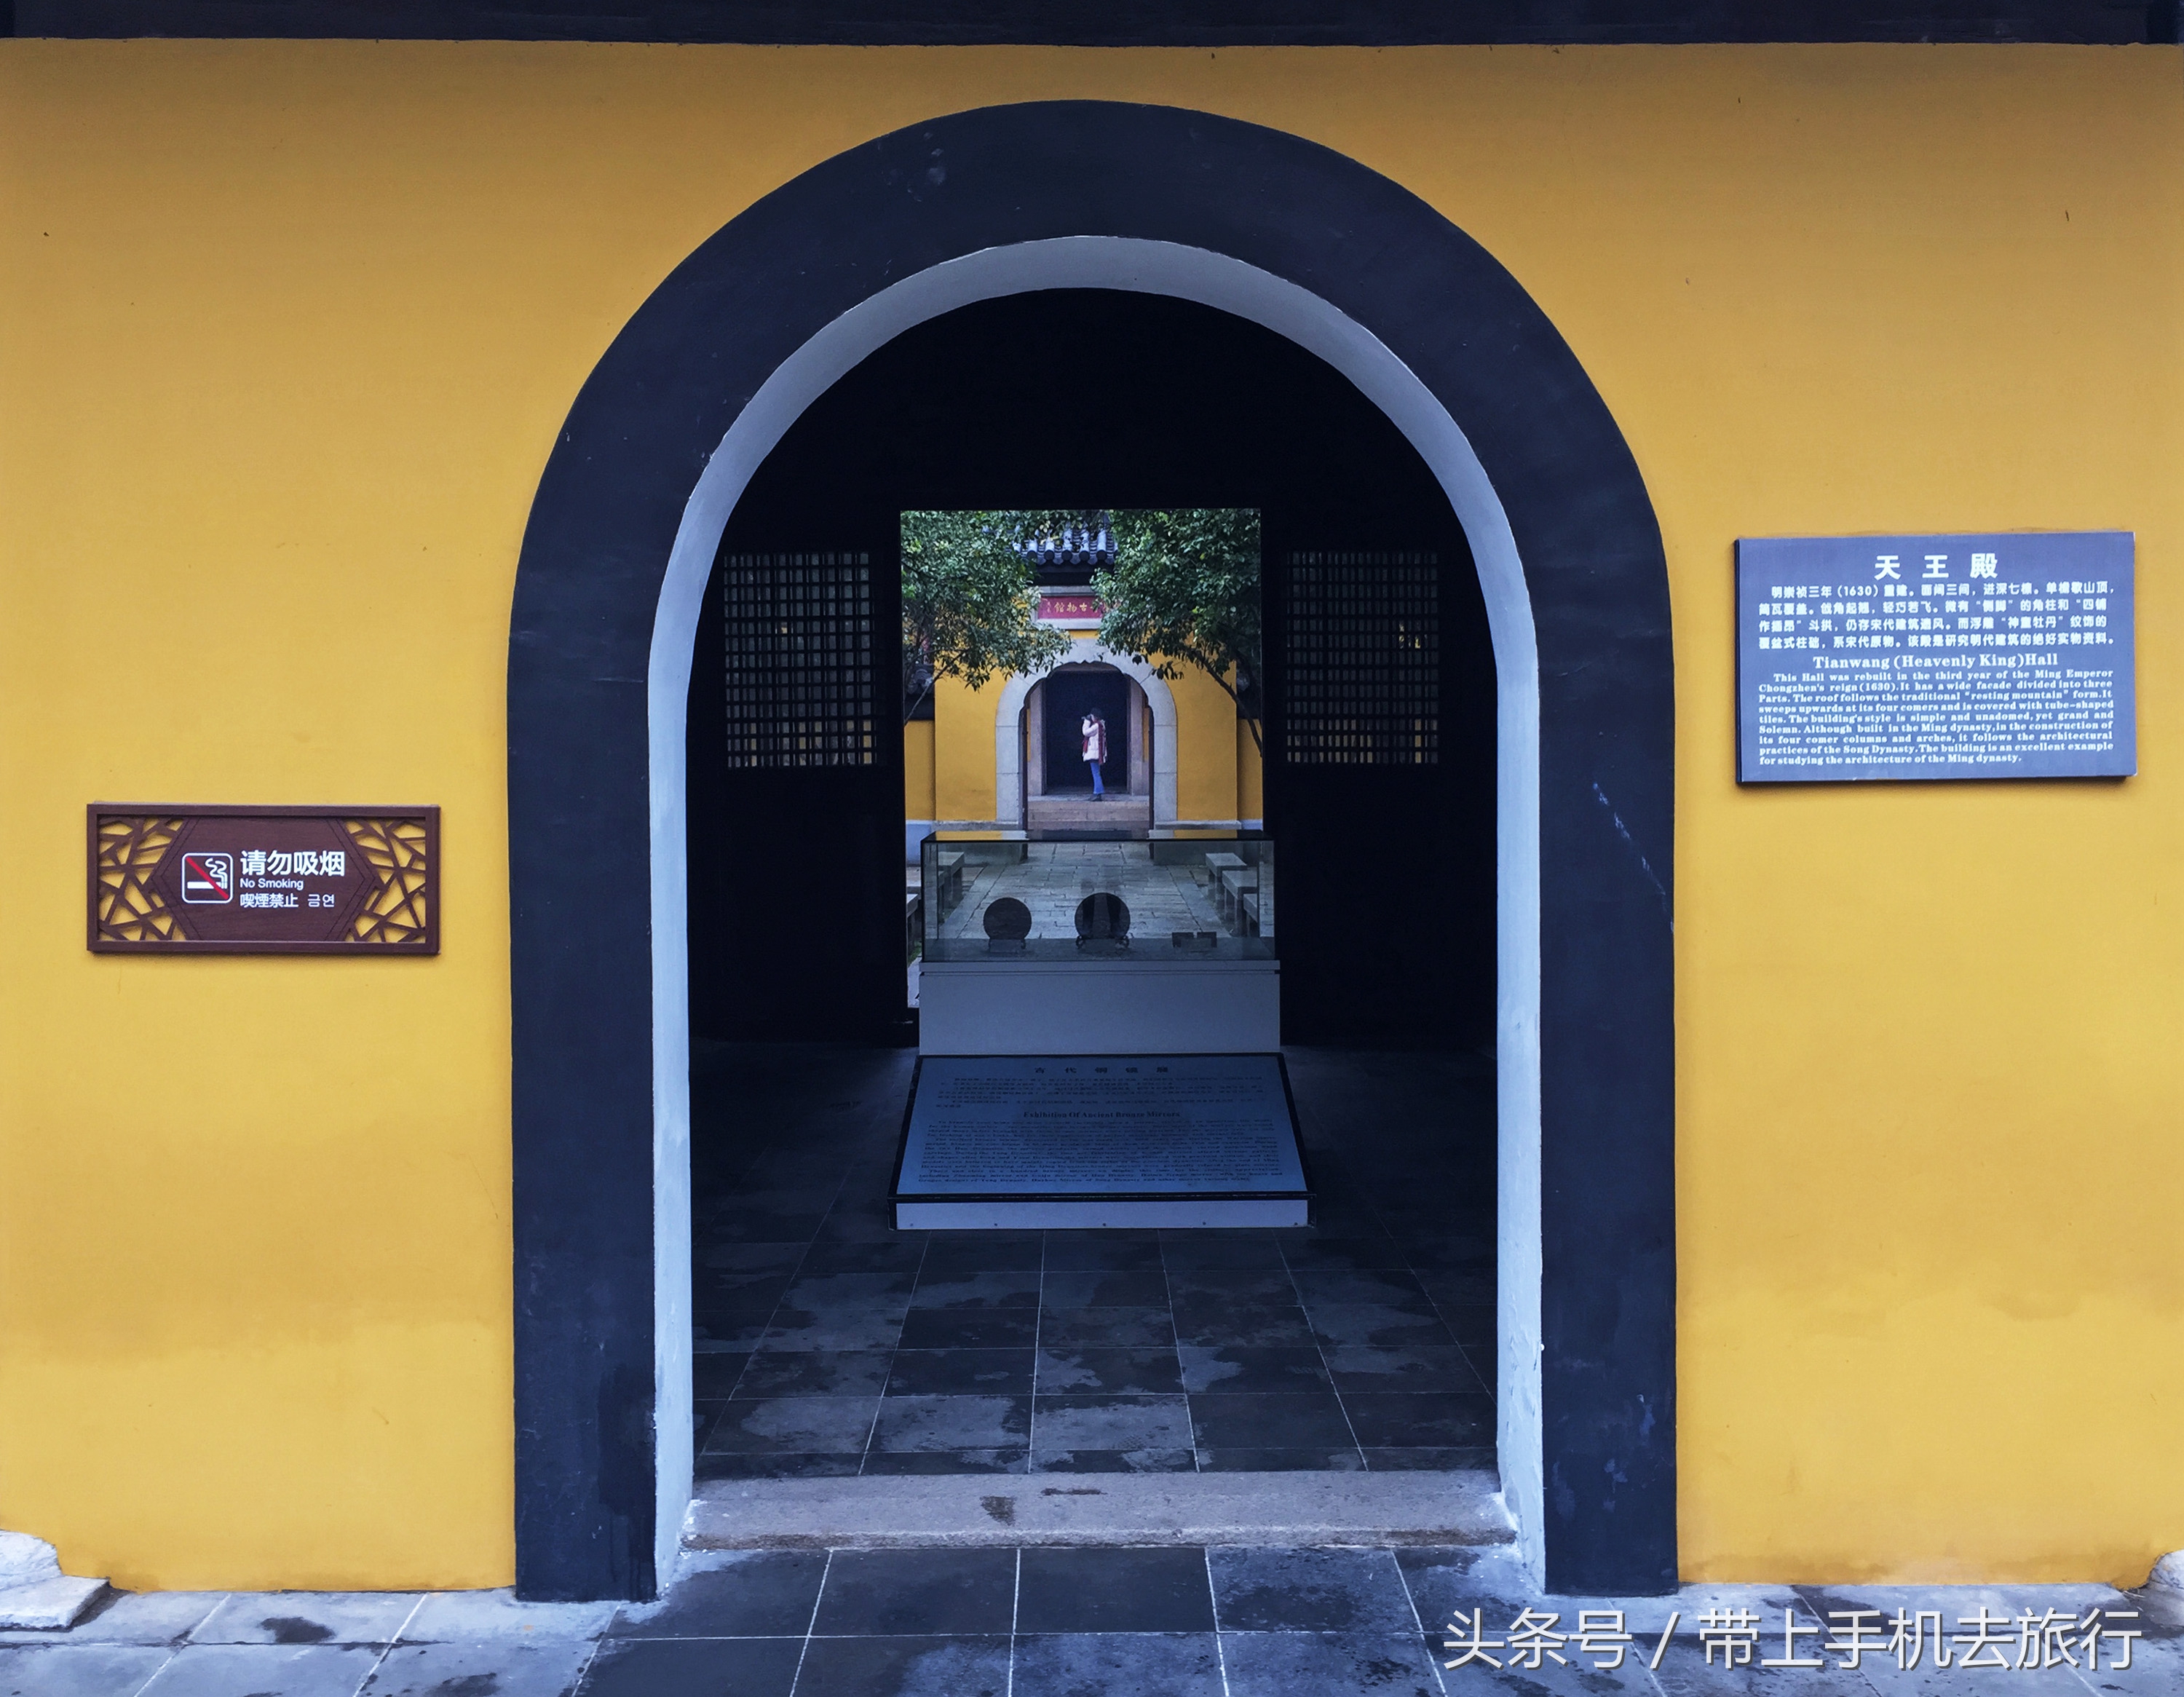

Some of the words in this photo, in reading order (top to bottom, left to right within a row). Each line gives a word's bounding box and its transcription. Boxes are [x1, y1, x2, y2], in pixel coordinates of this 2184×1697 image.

[1875, 553, 1998, 581] 天王殿
[1813, 657, 1891, 671] Tianwang
[1773, 673, 1797, 682] This
[1803, 673, 1824, 682] Hall
[1855, 672, 1892, 681] rebuilt
[1897, 672, 1908, 681] in
[1913, 672, 1930, 681] the
[1936, 671, 1962, 680] third
[1968, 673, 1991, 681] year
[1996, 671, 2009, 679] of
[2013, 671, 2030, 679] the
[2035, 670, 2062, 680] Ming
[2067, 669, 2113, 679] Emperor
[1915, 682, 1933, 691] has
[1947, 681, 1971, 690] wide
[1977, 681, 2011, 690] facade
[2017, 681, 2057, 689] divided
[2059, 680, 2081, 689] into
[2084, 679, 2113, 688] three
[1759, 695, 1791, 703] Parts.
[1793, 694, 1813, 703] The
[1816, 694, 1839, 703] roof
[1840, 694, 1880, 702] follows
[1883, 693, 1899, 702] the
[1902, 692, 1961, 701] traditional
[1759, 707, 1797, 715] sweeps
[1799, 705, 1844, 715] upwards
[1846, 705, 1857, 713] at
[1859, 704, 1873, 713] its
[1876, 704, 1899, 712] four
[1941, 703, 1961, 711] and
[1963, 703, 1972, 711] is
[1974, 702, 2017, 711] covered
[2019, 701, 2043, 710] with
[1760, 715, 1787, 724] tiles.
[1789, 715, 1809, 724] The
[1865, 714, 1891, 724] style
[1897, 713, 1906, 722] is
[1911, 713, 1946, 724] simple
[1951, 713, 1970, 721] and
[1976, 712, 2033, 721] unadomed,
[2036, 712, 2053, 721] yet
[2058, 711, 2089, 721] grand
[2094, 711, 2114, 719] and
[1760, 725, 1802, 734] Solemn.
[1804, 724, 1853, 735] Although
[1858, 724, 1883, 733] built
[1888, 724, 1899, 733] in
[1902, 724, 1919, 732] the
[1922, 724, 1947, 733] Ming
[2009, 722, 2027, 731] the
[2029, 721, 2099, 730] construction
[2101, 721, 2113, 729] of
[1760, 736, 1773, 745] its
[1779, 736, 1802, 745] four
[1843, 735, 1888, 743] columns
[1893, 735, 1912, 743] and
[1917, 734, 1955, 743] arches,
[1960, 733, 1968, 742] it
[1973, 733, 2012, 742] follows
[2018, 732, 2035, 741] the
[2040, 731, 2113, 741] architectural
[1760, 746, 1808, 756] practices
[1811, 746, 1823, 754] of
[1824, 745, 1841, 754] the
[1843, 745, 1870, 755] Song
[1942, 744, 1986, 753] building
[1988, 743, 1998, 752] is
[2015, 743, 2065, 751] excellent
[2068, 742, 2114, 752] example
[1760, 756, 1776, 765] for
[1778, 756, 1824, 766] studying
[1826, 756, 1843, 764] the
[1845, 755, 1912, 764] architecture
[1915, 755, 1927, 764] of
[1928, 754, 1945, 763] the
[1948, 754, 1974, 764] Ming
[1977, 753, 2022, 764] dynasty.
[240, 850, 344, 877] 请勿吸烟
[240, 878, 256, 887] No
[258, 878, 304, 890] Smoking
[240, 893, 298, 908] 喫煙禁止
[308, 894, 334, 907] 금연
